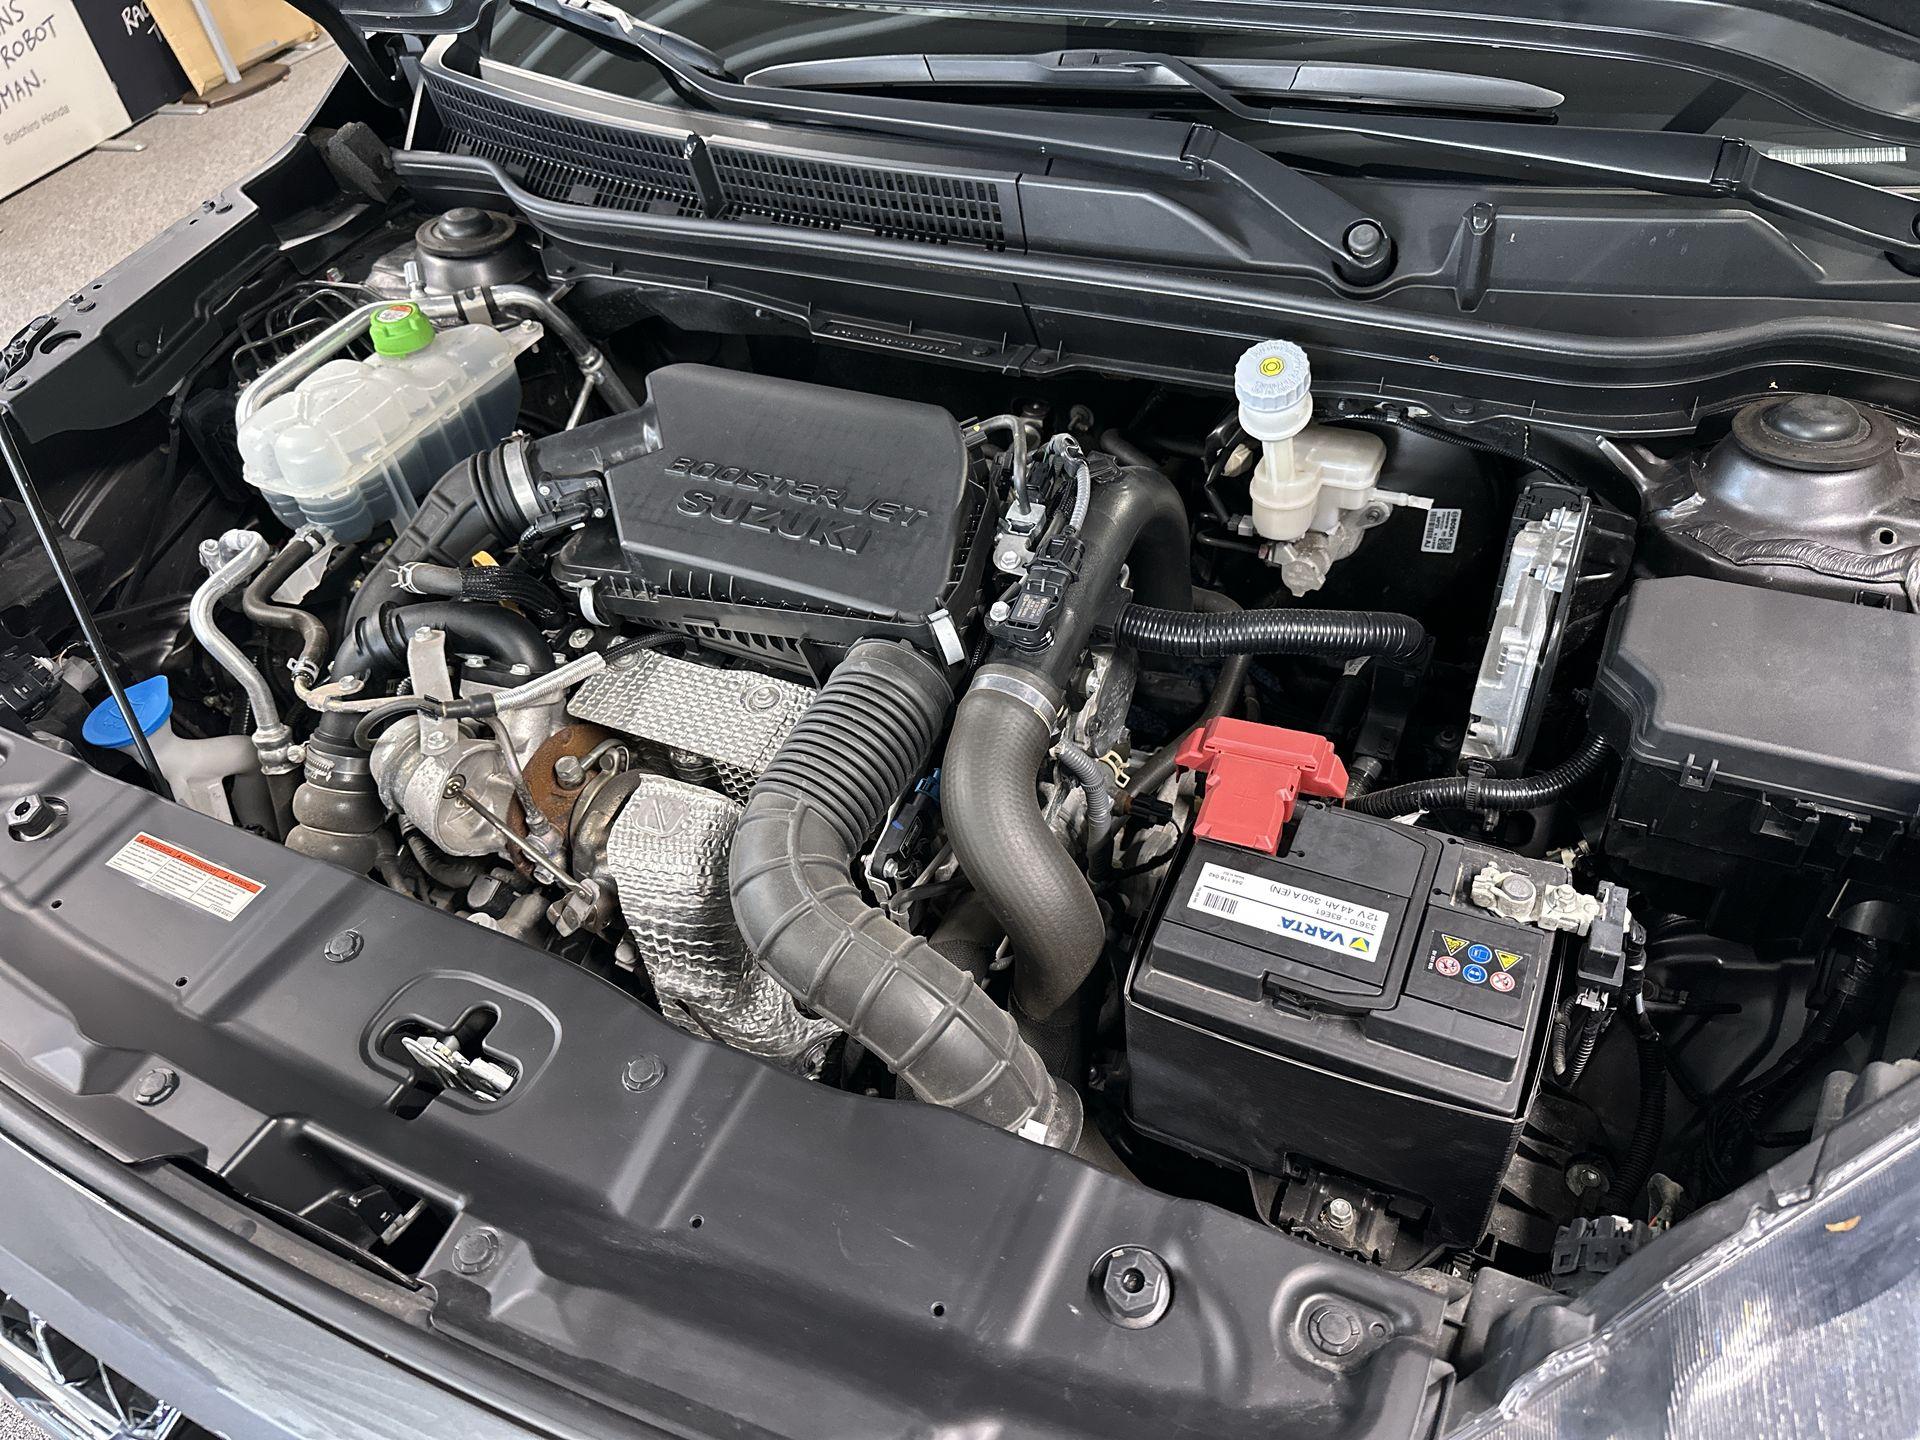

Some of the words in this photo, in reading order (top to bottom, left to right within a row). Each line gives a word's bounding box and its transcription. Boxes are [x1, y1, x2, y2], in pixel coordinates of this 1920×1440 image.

[0, 14, 55, 69] ROBOT
[41, 104, 70, 126] Honda
[664, 456, 929, 527] BOOSTERJET
[677, 489, 873, 555] SUZUKI
[1316, 908, 1342, 920] 83E61
[1349, 918, 1377, 931] 33610
[1281, 916, 1345, 946] VARTA
